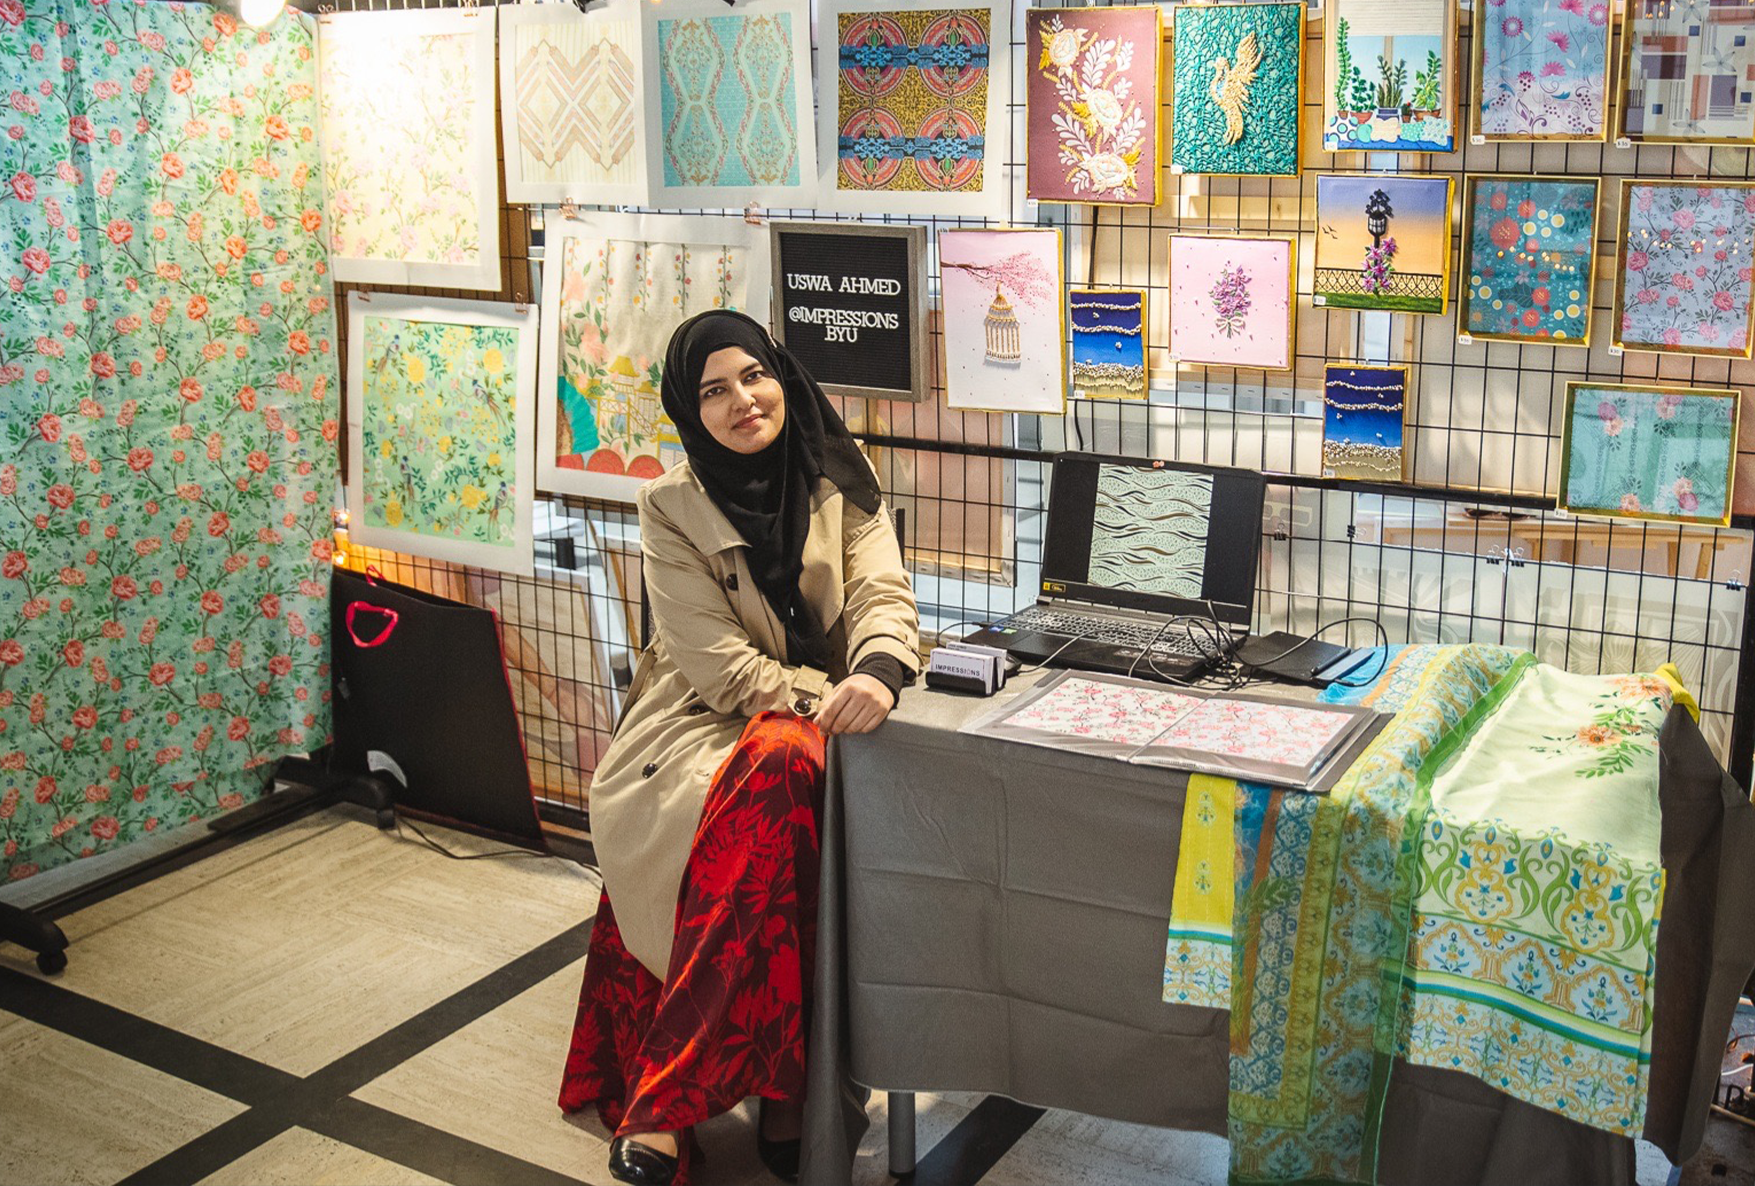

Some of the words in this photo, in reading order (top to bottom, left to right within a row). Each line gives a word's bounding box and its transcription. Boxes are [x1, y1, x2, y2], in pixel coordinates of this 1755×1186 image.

[787, 273, 833, 292] USWA
[838, 276, 901, 296] AHMED
[789, 306, 899, 329] @IMPRESSIONS
[935, 663, 980, 677] IMPRESSIONS
